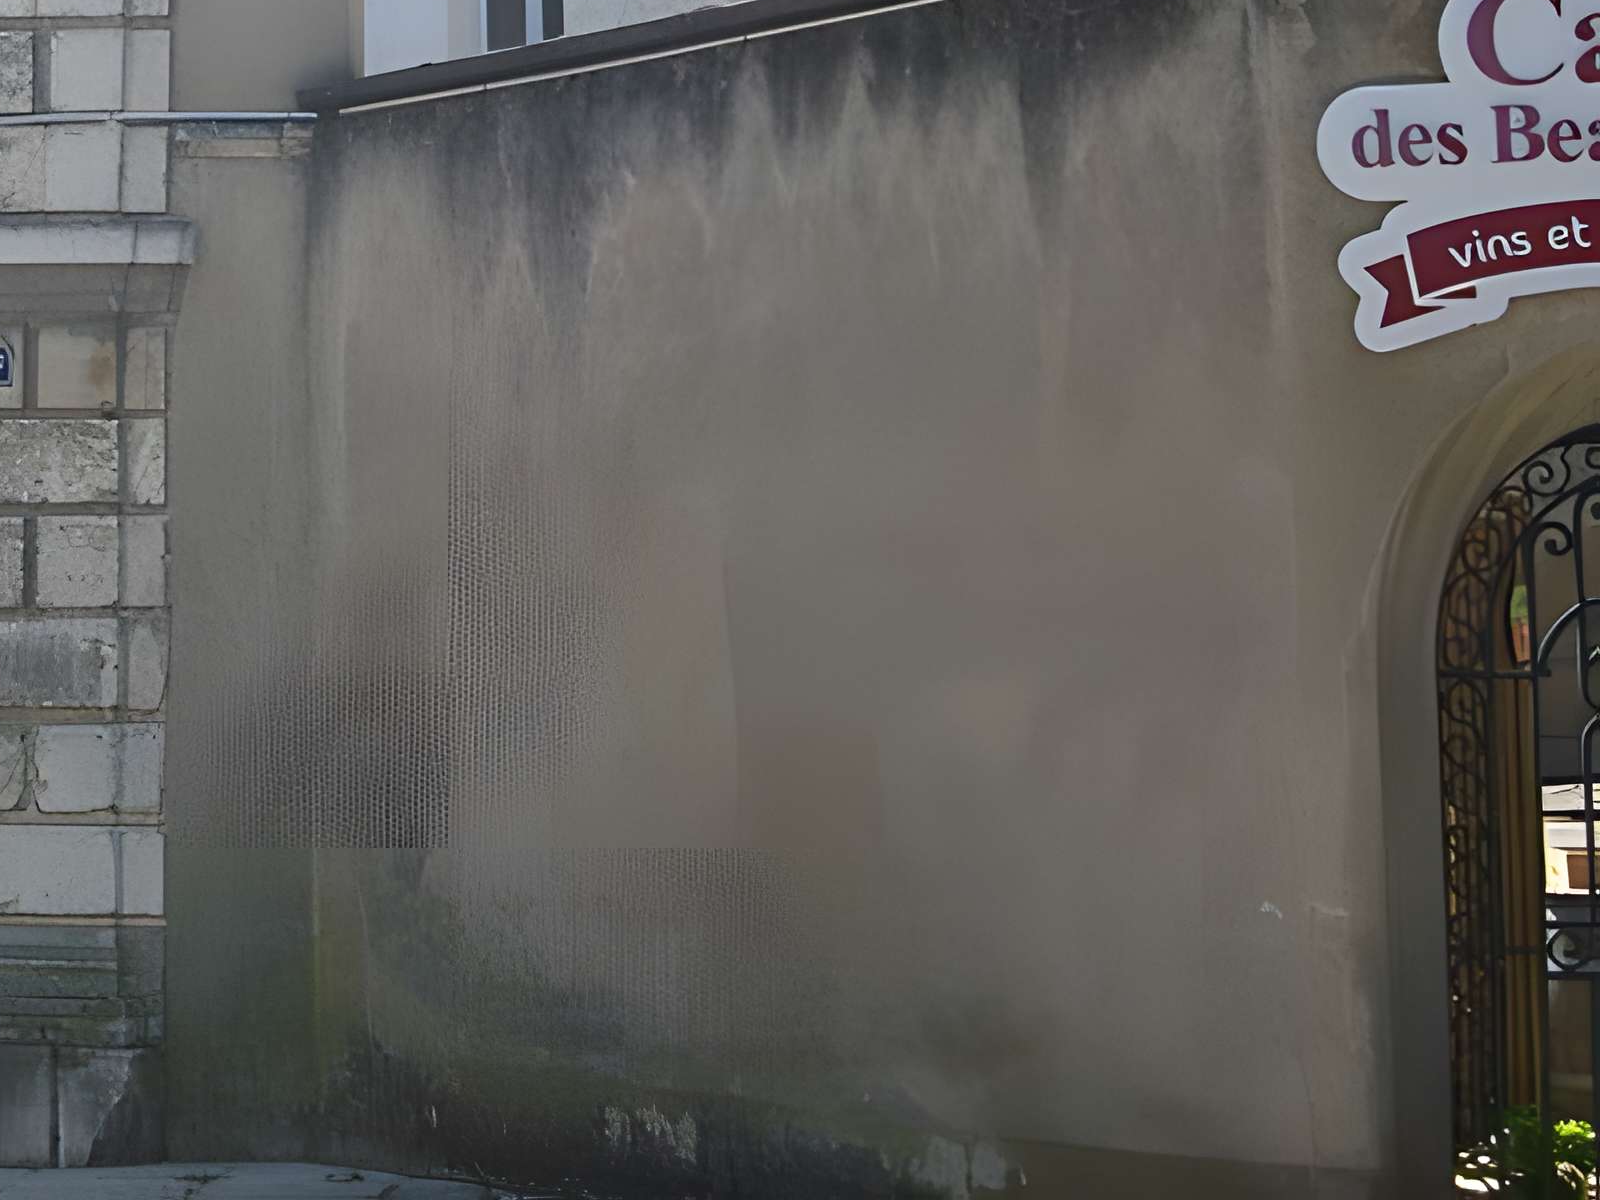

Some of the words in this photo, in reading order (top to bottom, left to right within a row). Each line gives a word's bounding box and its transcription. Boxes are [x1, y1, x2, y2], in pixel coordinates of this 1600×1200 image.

[1351, 108, 1469, 168] des
[1448, 229, 1532, 268] vins
[1548, 215, 1592, 251] et
